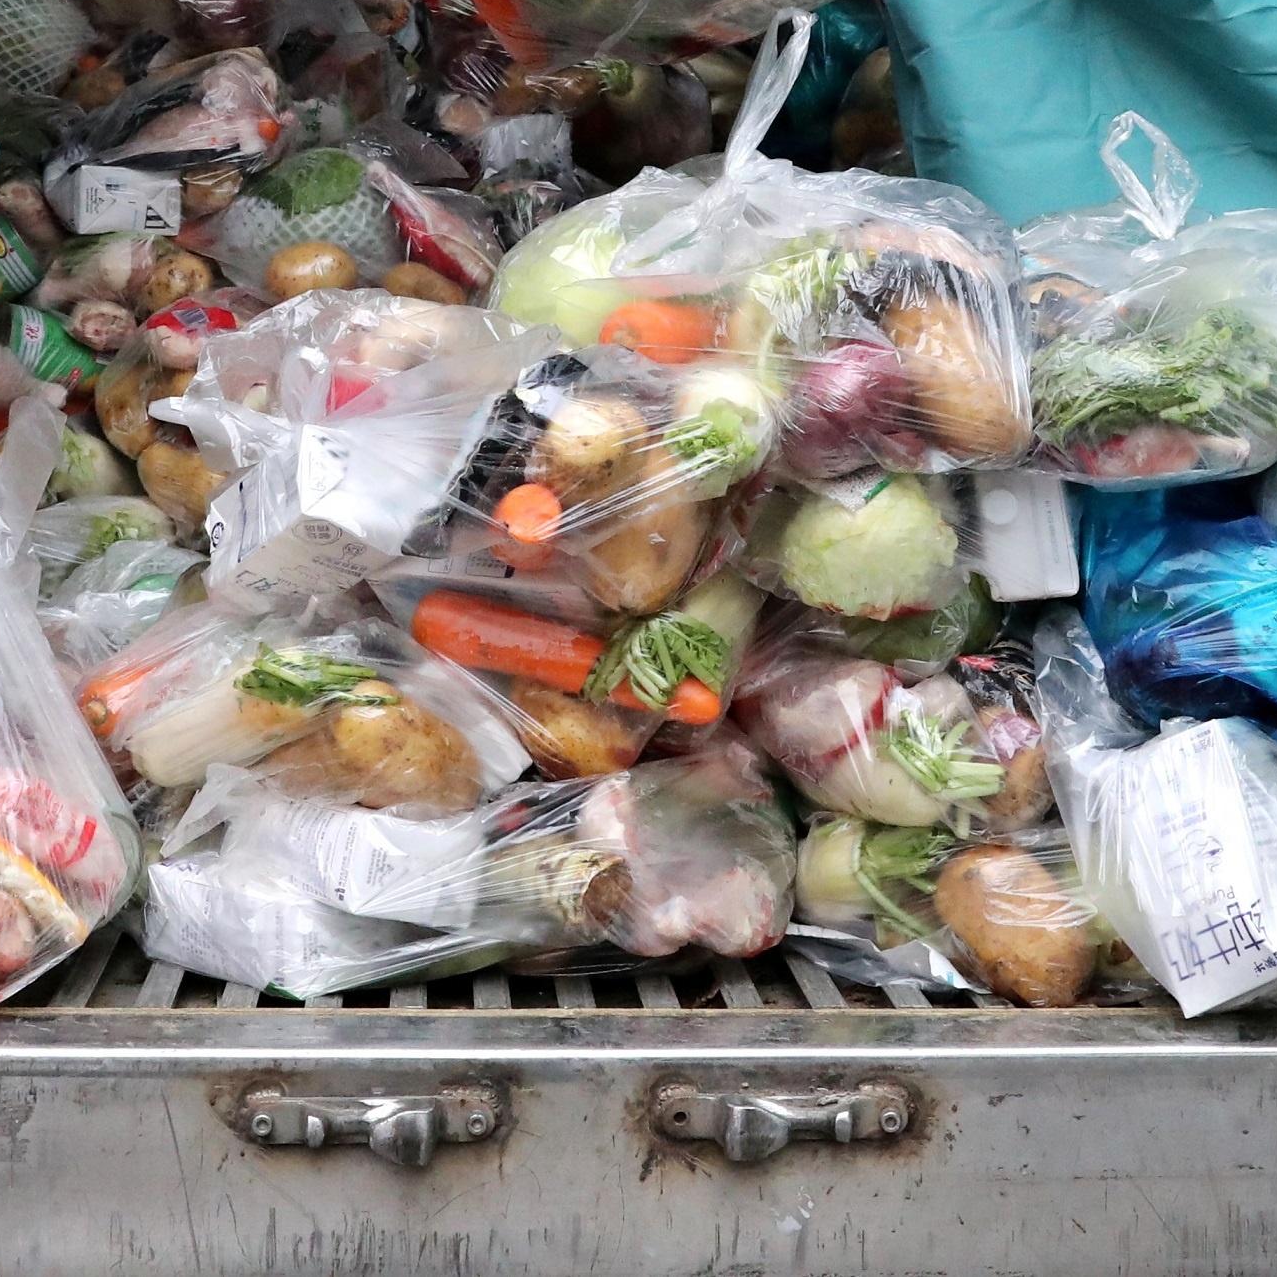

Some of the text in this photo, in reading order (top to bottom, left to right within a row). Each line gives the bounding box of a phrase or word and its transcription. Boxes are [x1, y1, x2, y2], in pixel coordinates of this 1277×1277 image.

[1160, 898, 1267, 982] 纯牛奶
[1253, 952, 1277, 976] 蒙牛
